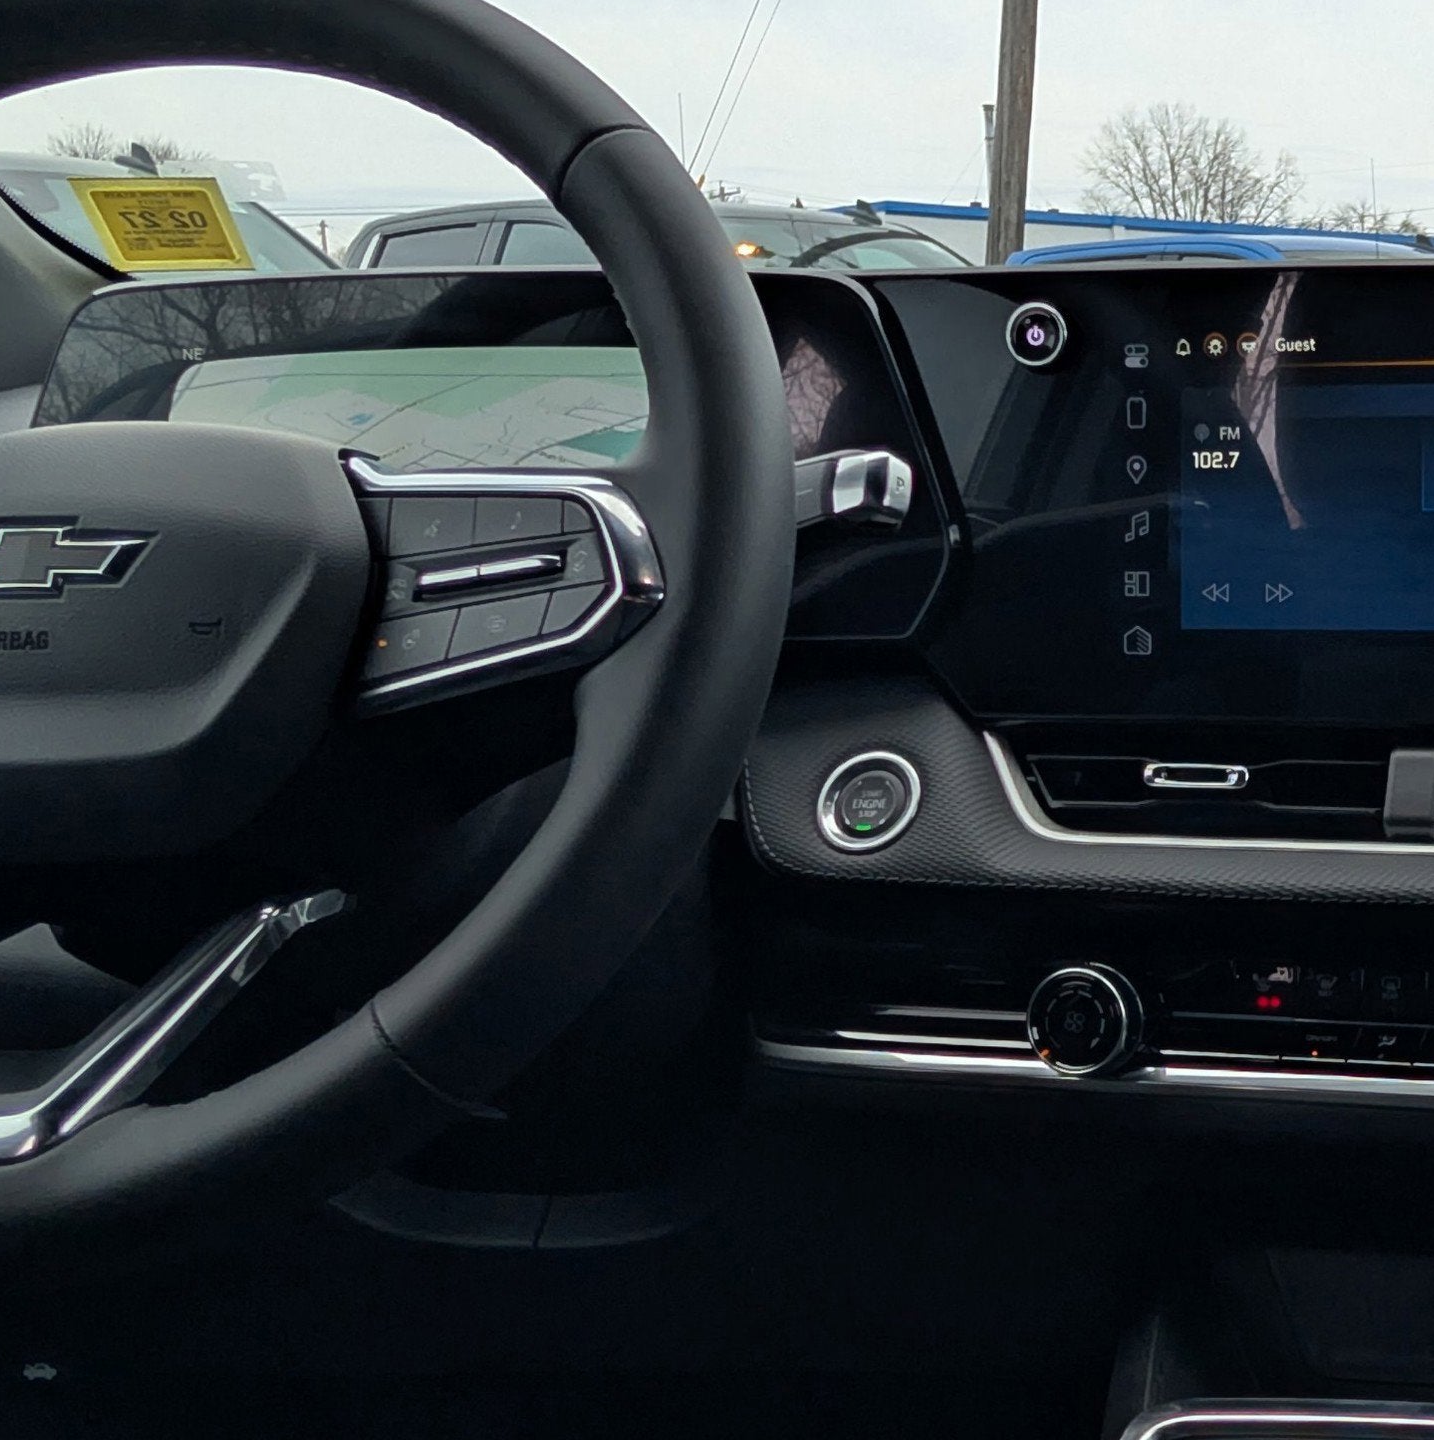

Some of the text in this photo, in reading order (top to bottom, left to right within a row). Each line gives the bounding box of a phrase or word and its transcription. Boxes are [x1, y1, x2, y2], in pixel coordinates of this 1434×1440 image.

[1274, 337, 1316, 352] Guest
[1219, 426, 1241, 441] FM
[1192, 451, 1240, 469] 102.7
[852, 798, 887, 809] ENGINE
